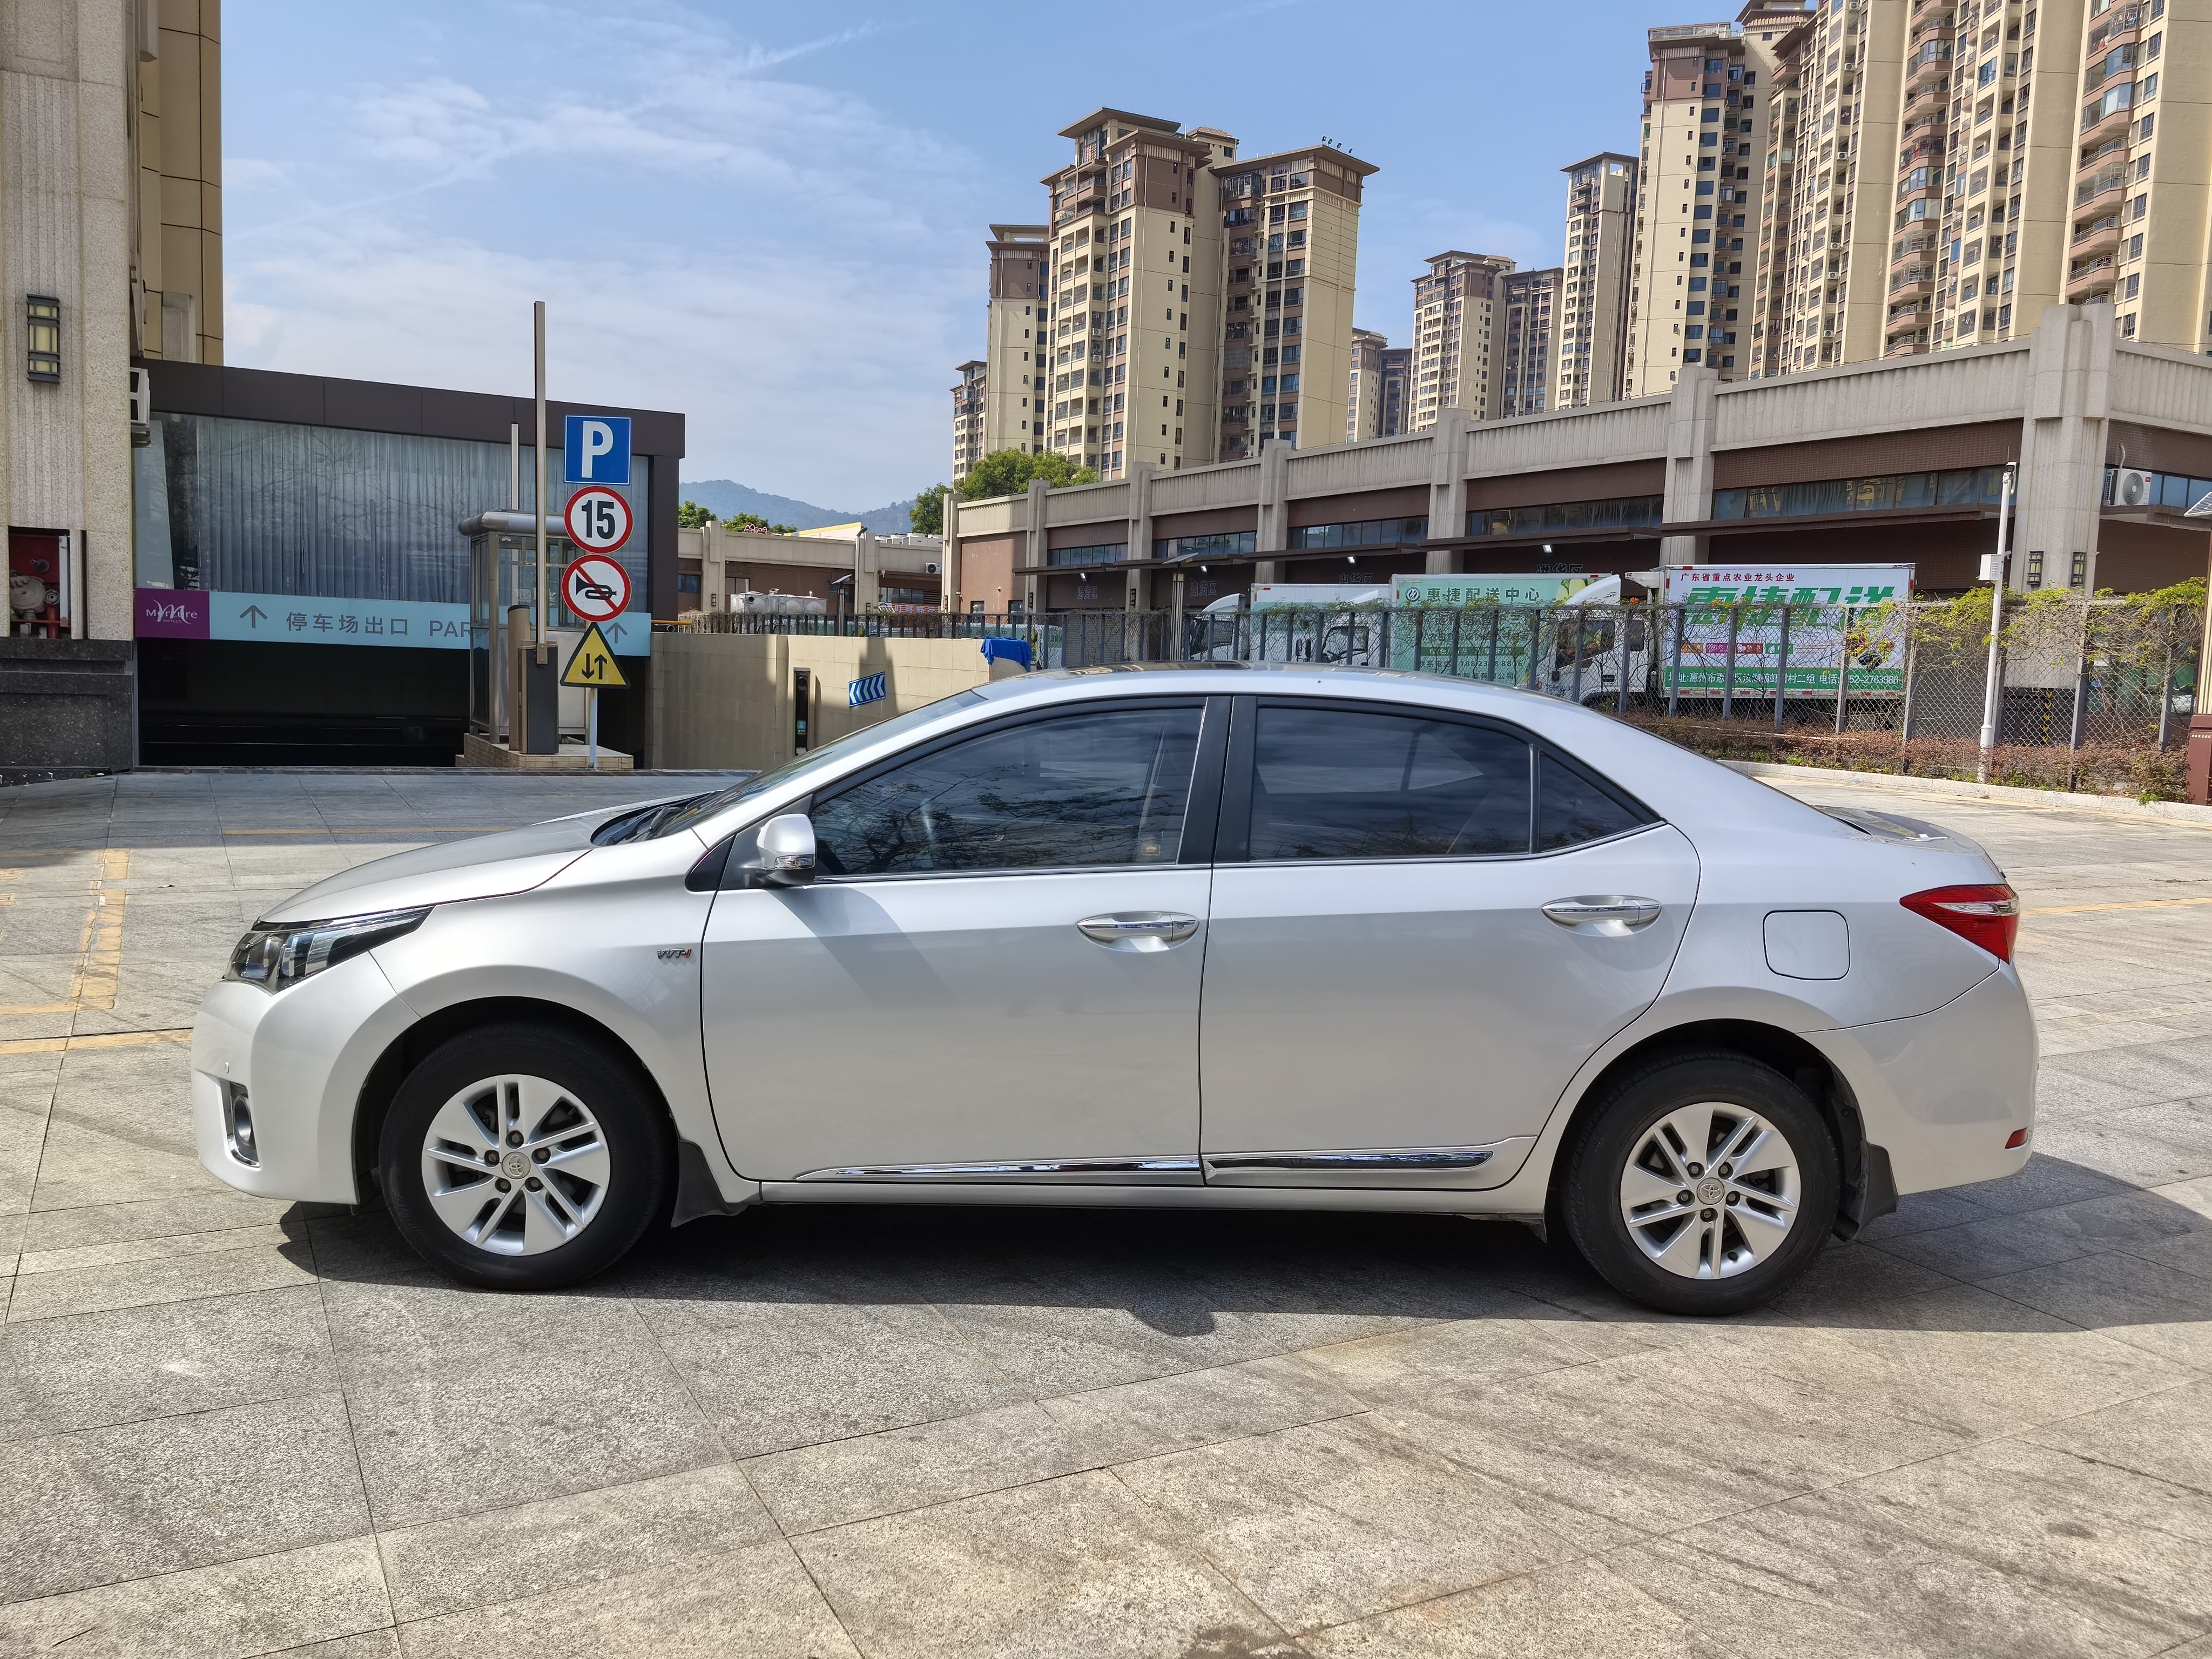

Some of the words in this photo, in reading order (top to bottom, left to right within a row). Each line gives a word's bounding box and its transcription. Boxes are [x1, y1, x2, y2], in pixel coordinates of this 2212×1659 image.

[581, 421, 613, 478] P
[581, 500, 616, 539] 15
[1681, 572, 1796, 582] 广东省重点农业龙头企业
[1190, 580, 1217, 597] 出货区
[1426, 586, 1540, 602] 惠捷配送中心
[286, 611, 409, 636] 停车场出口
